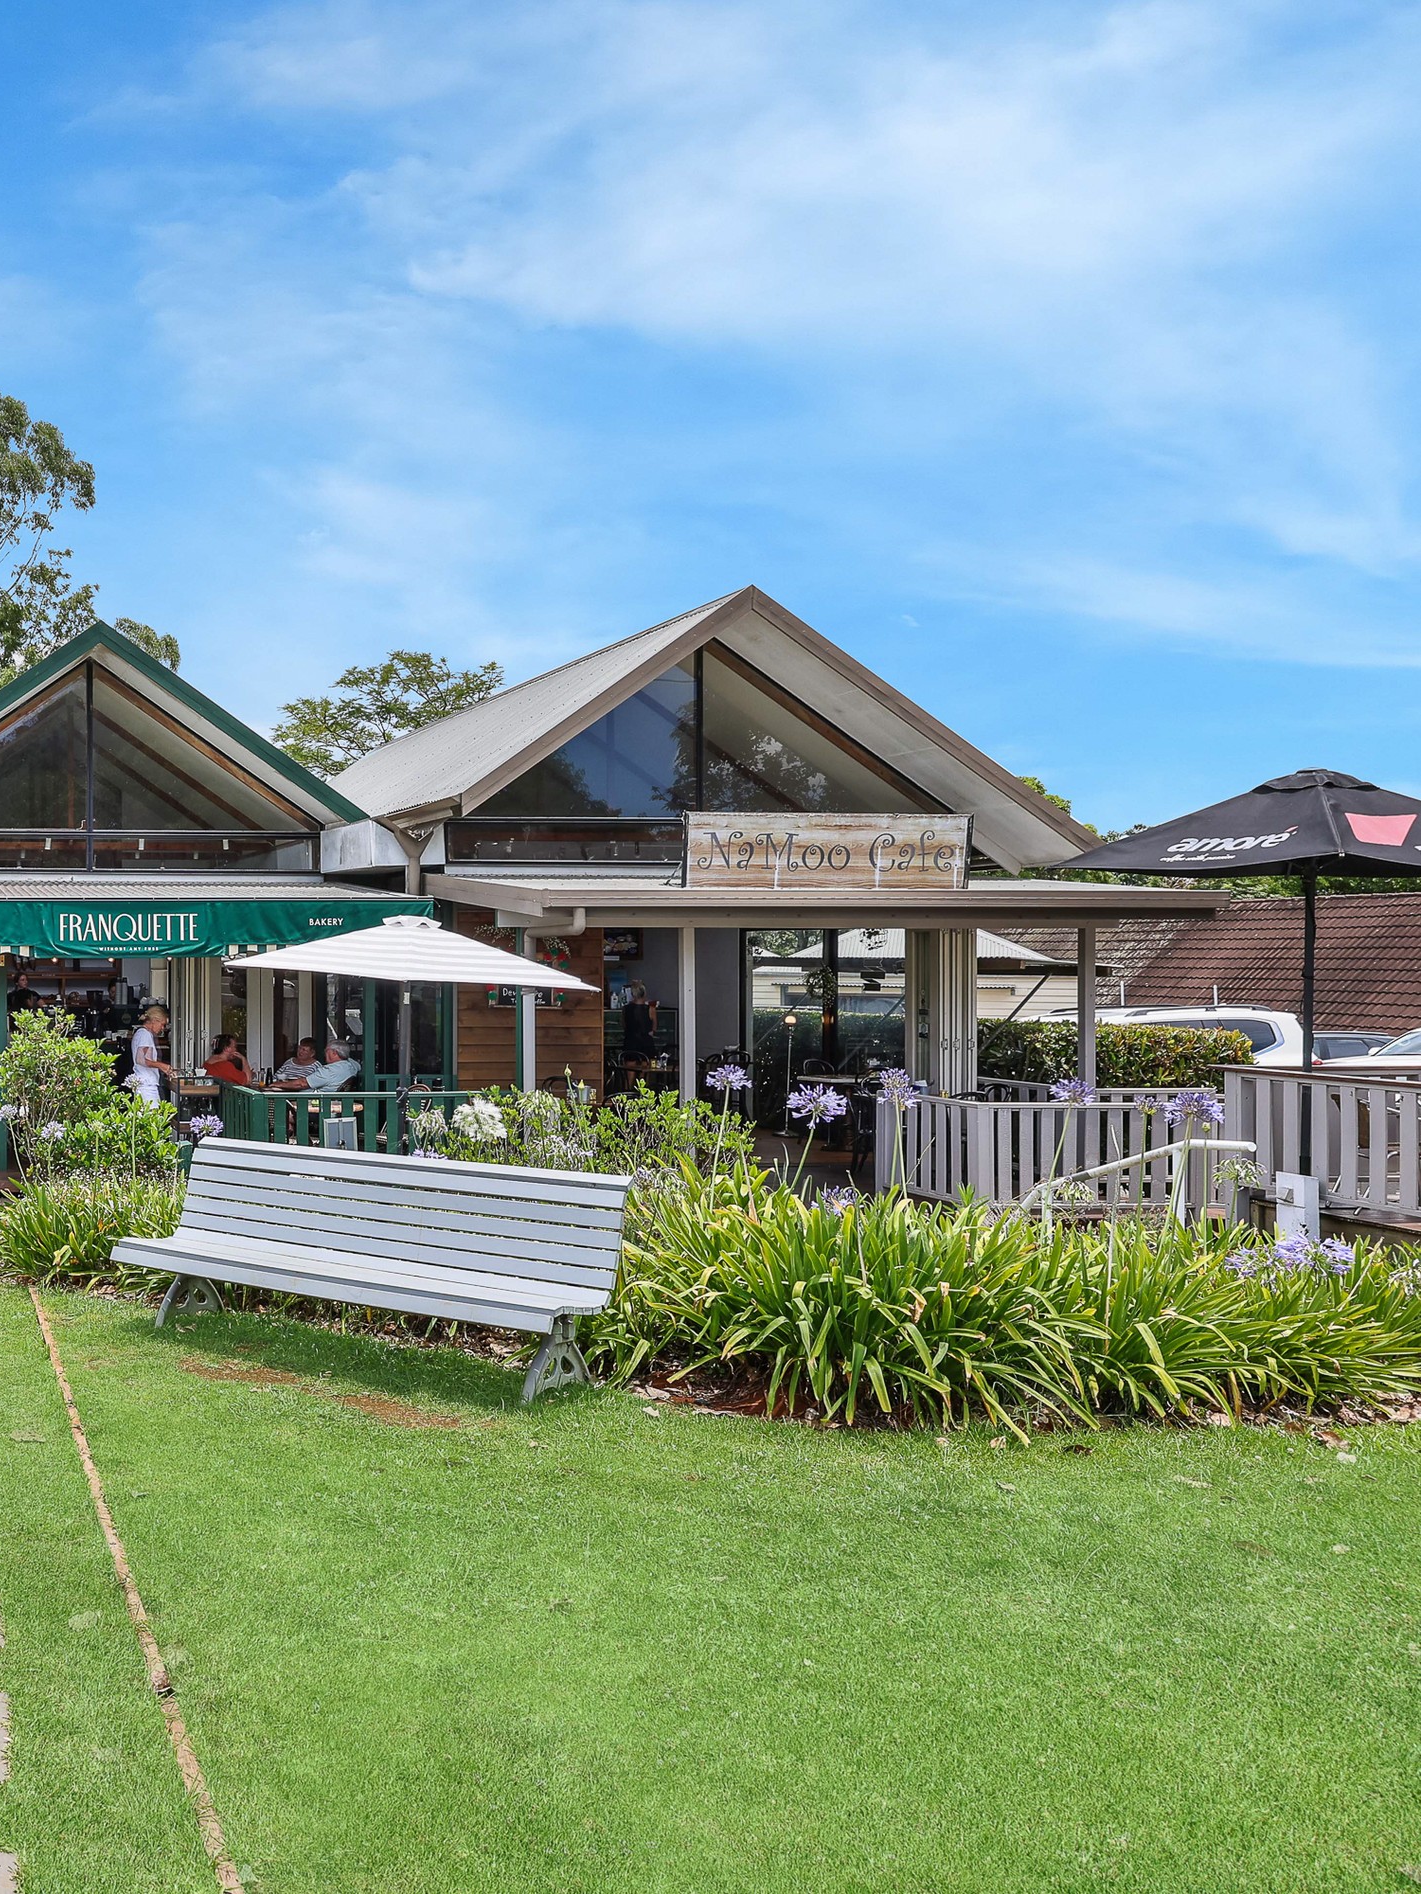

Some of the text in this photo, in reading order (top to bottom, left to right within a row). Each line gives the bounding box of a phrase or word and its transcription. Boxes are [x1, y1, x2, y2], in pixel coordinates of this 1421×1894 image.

[697, 830, 955, 872] NaMoo Cafe
[59, 913, 199, 942] FRANQUETTE
[308, 917, 344, 926] BAKERY
